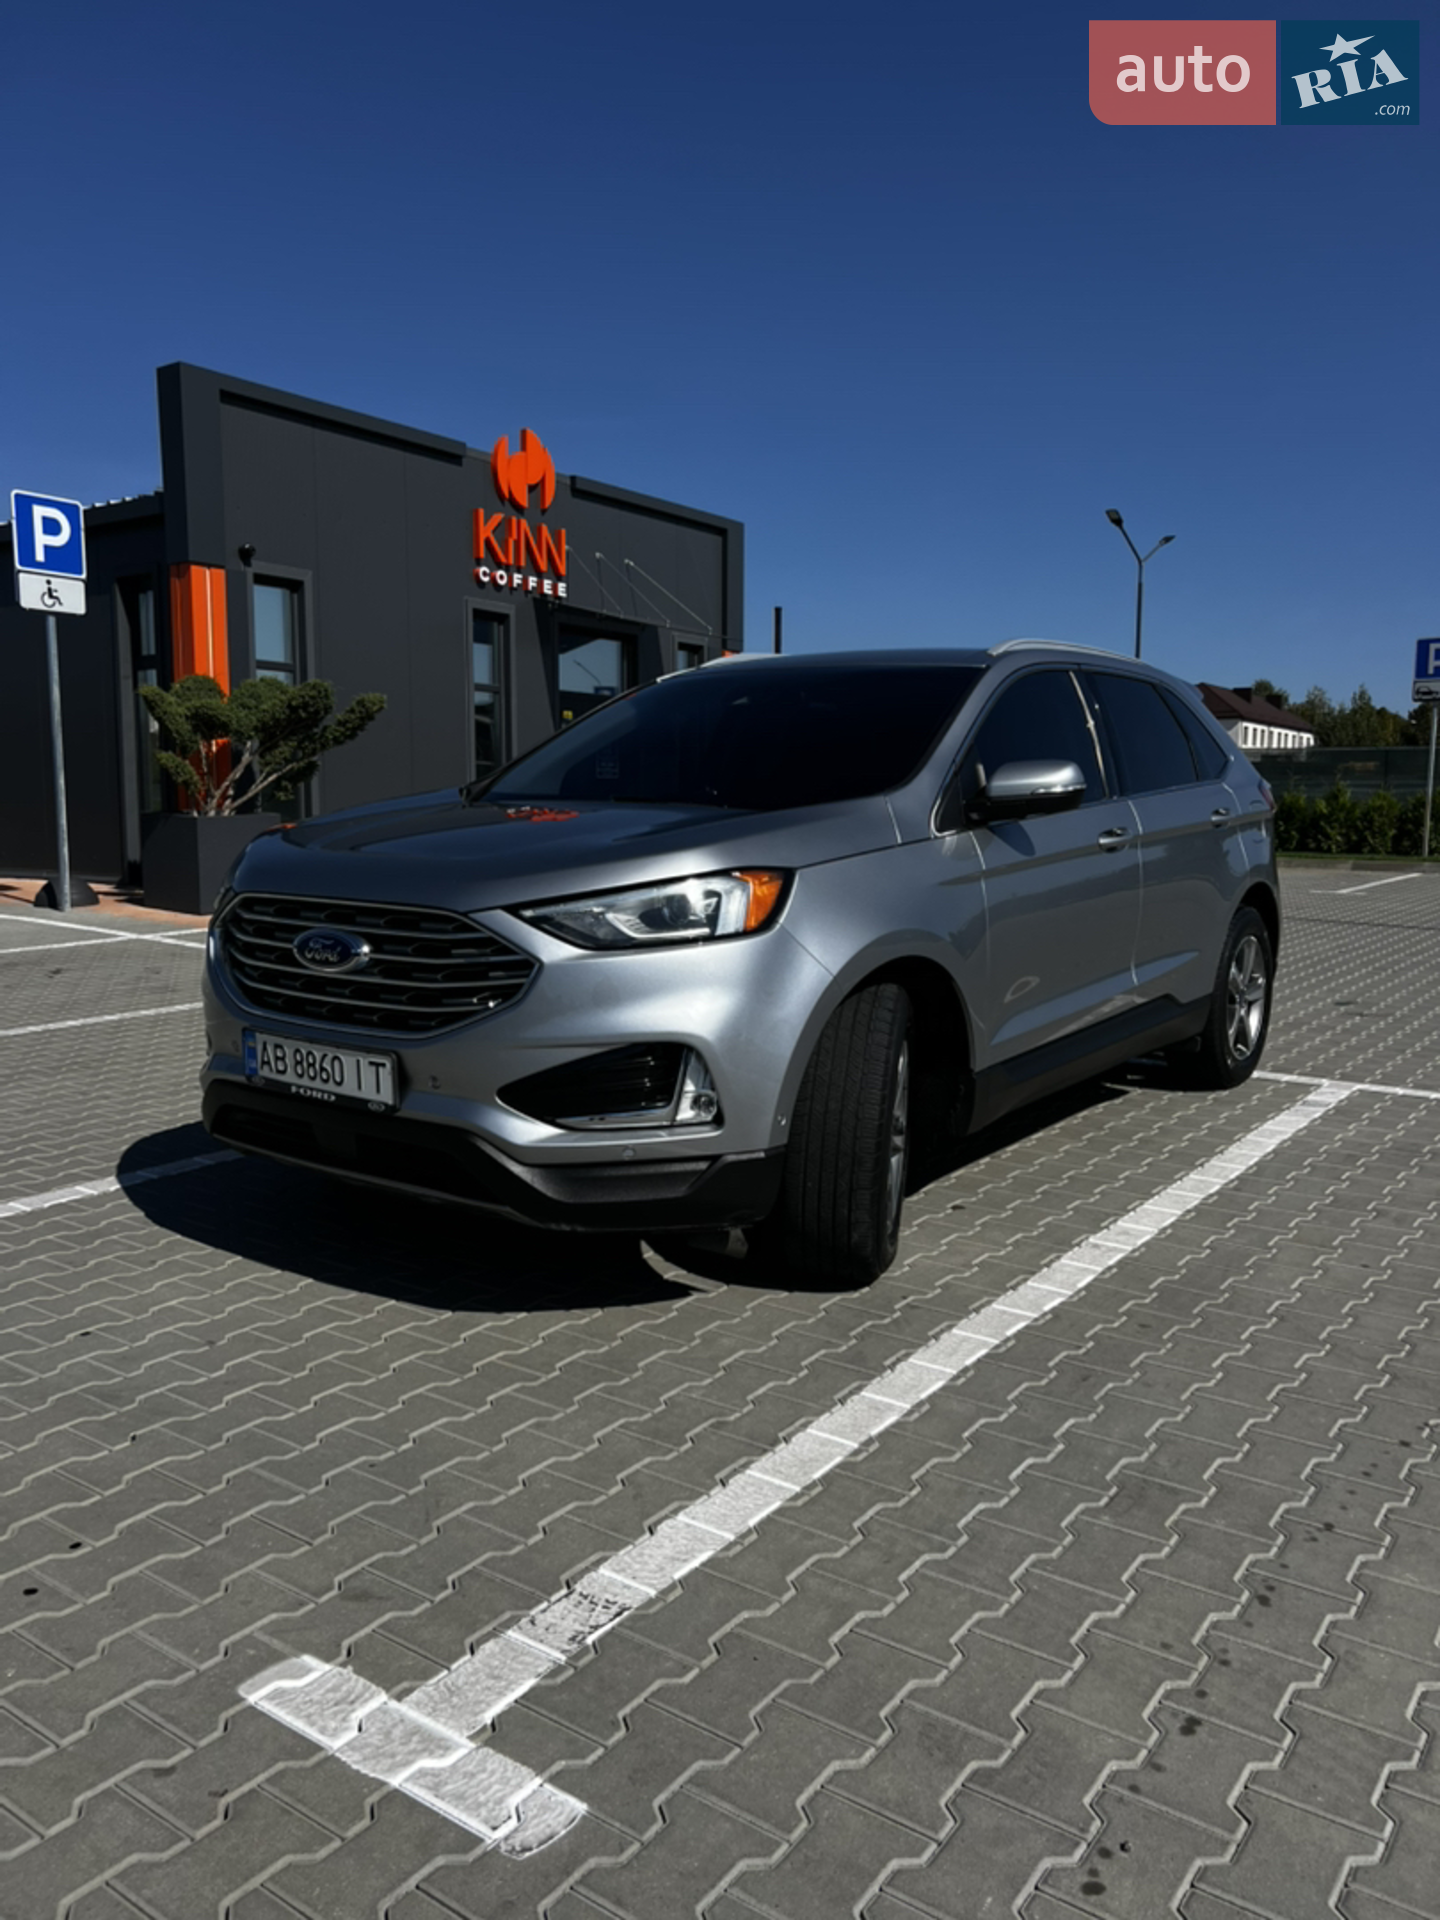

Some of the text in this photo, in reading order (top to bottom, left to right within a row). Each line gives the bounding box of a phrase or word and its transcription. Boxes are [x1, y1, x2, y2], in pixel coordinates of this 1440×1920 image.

[31, 503, 72, 563] P
[472, 507, 567, 577] KINN
[474, 566, 568, 598] COFFEE
[303, 936, 343, 963] Ford
[260, 1040, 388, 1095] AB 8860 IT
